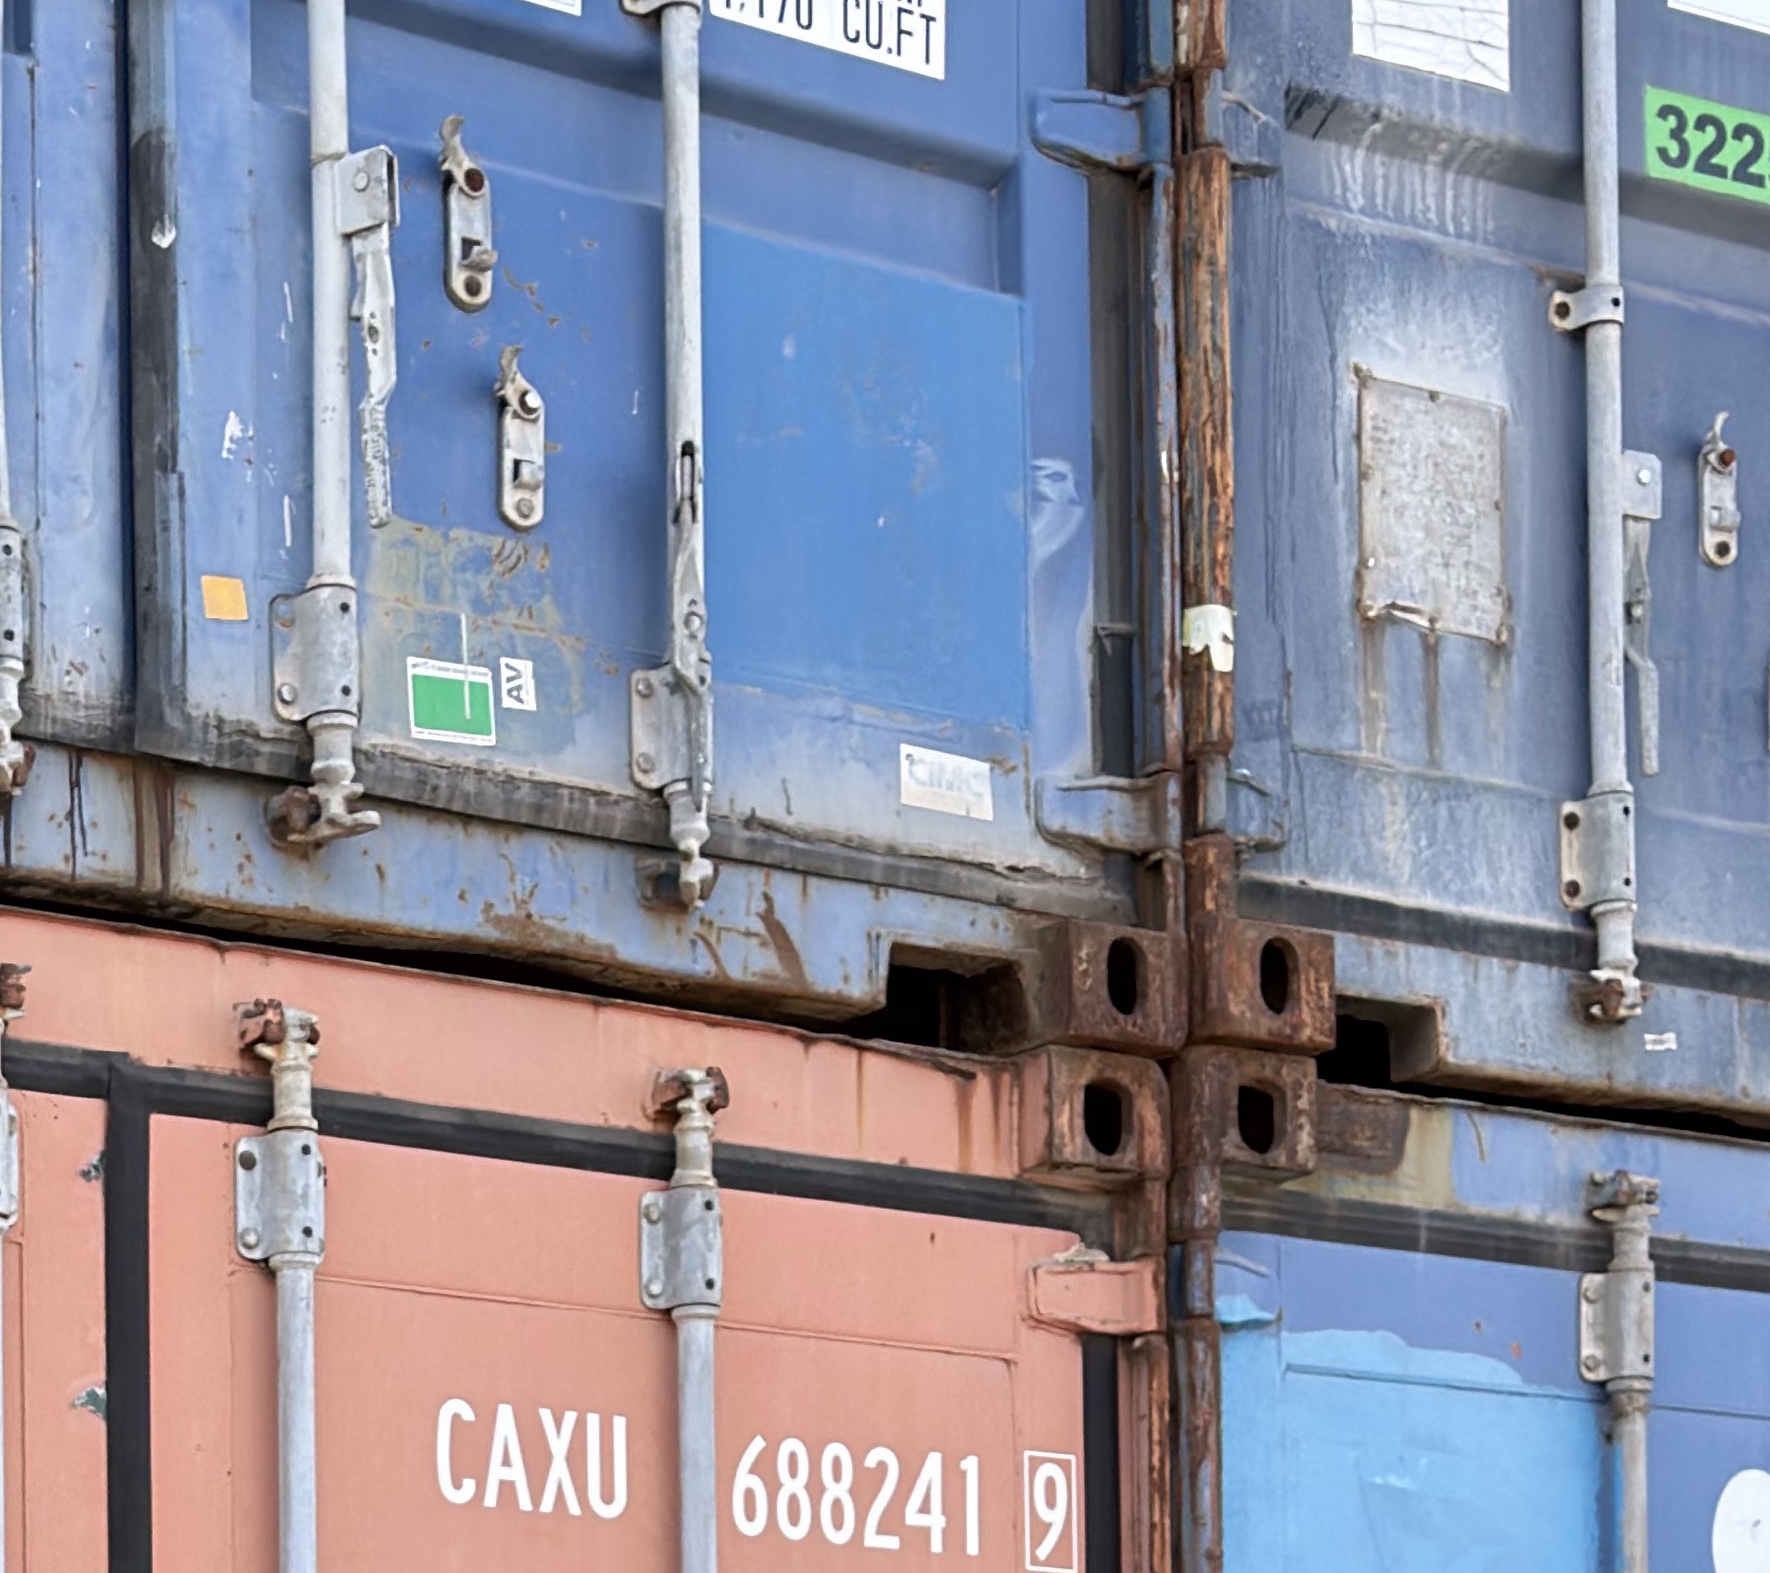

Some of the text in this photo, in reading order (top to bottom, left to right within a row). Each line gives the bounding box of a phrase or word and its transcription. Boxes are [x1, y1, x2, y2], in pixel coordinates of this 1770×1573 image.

[1656, 104, 1770, 189] 322
[505, 661, 525, 705] AV
[437, 1399, 1069, 1561] CAXU 688241 9
